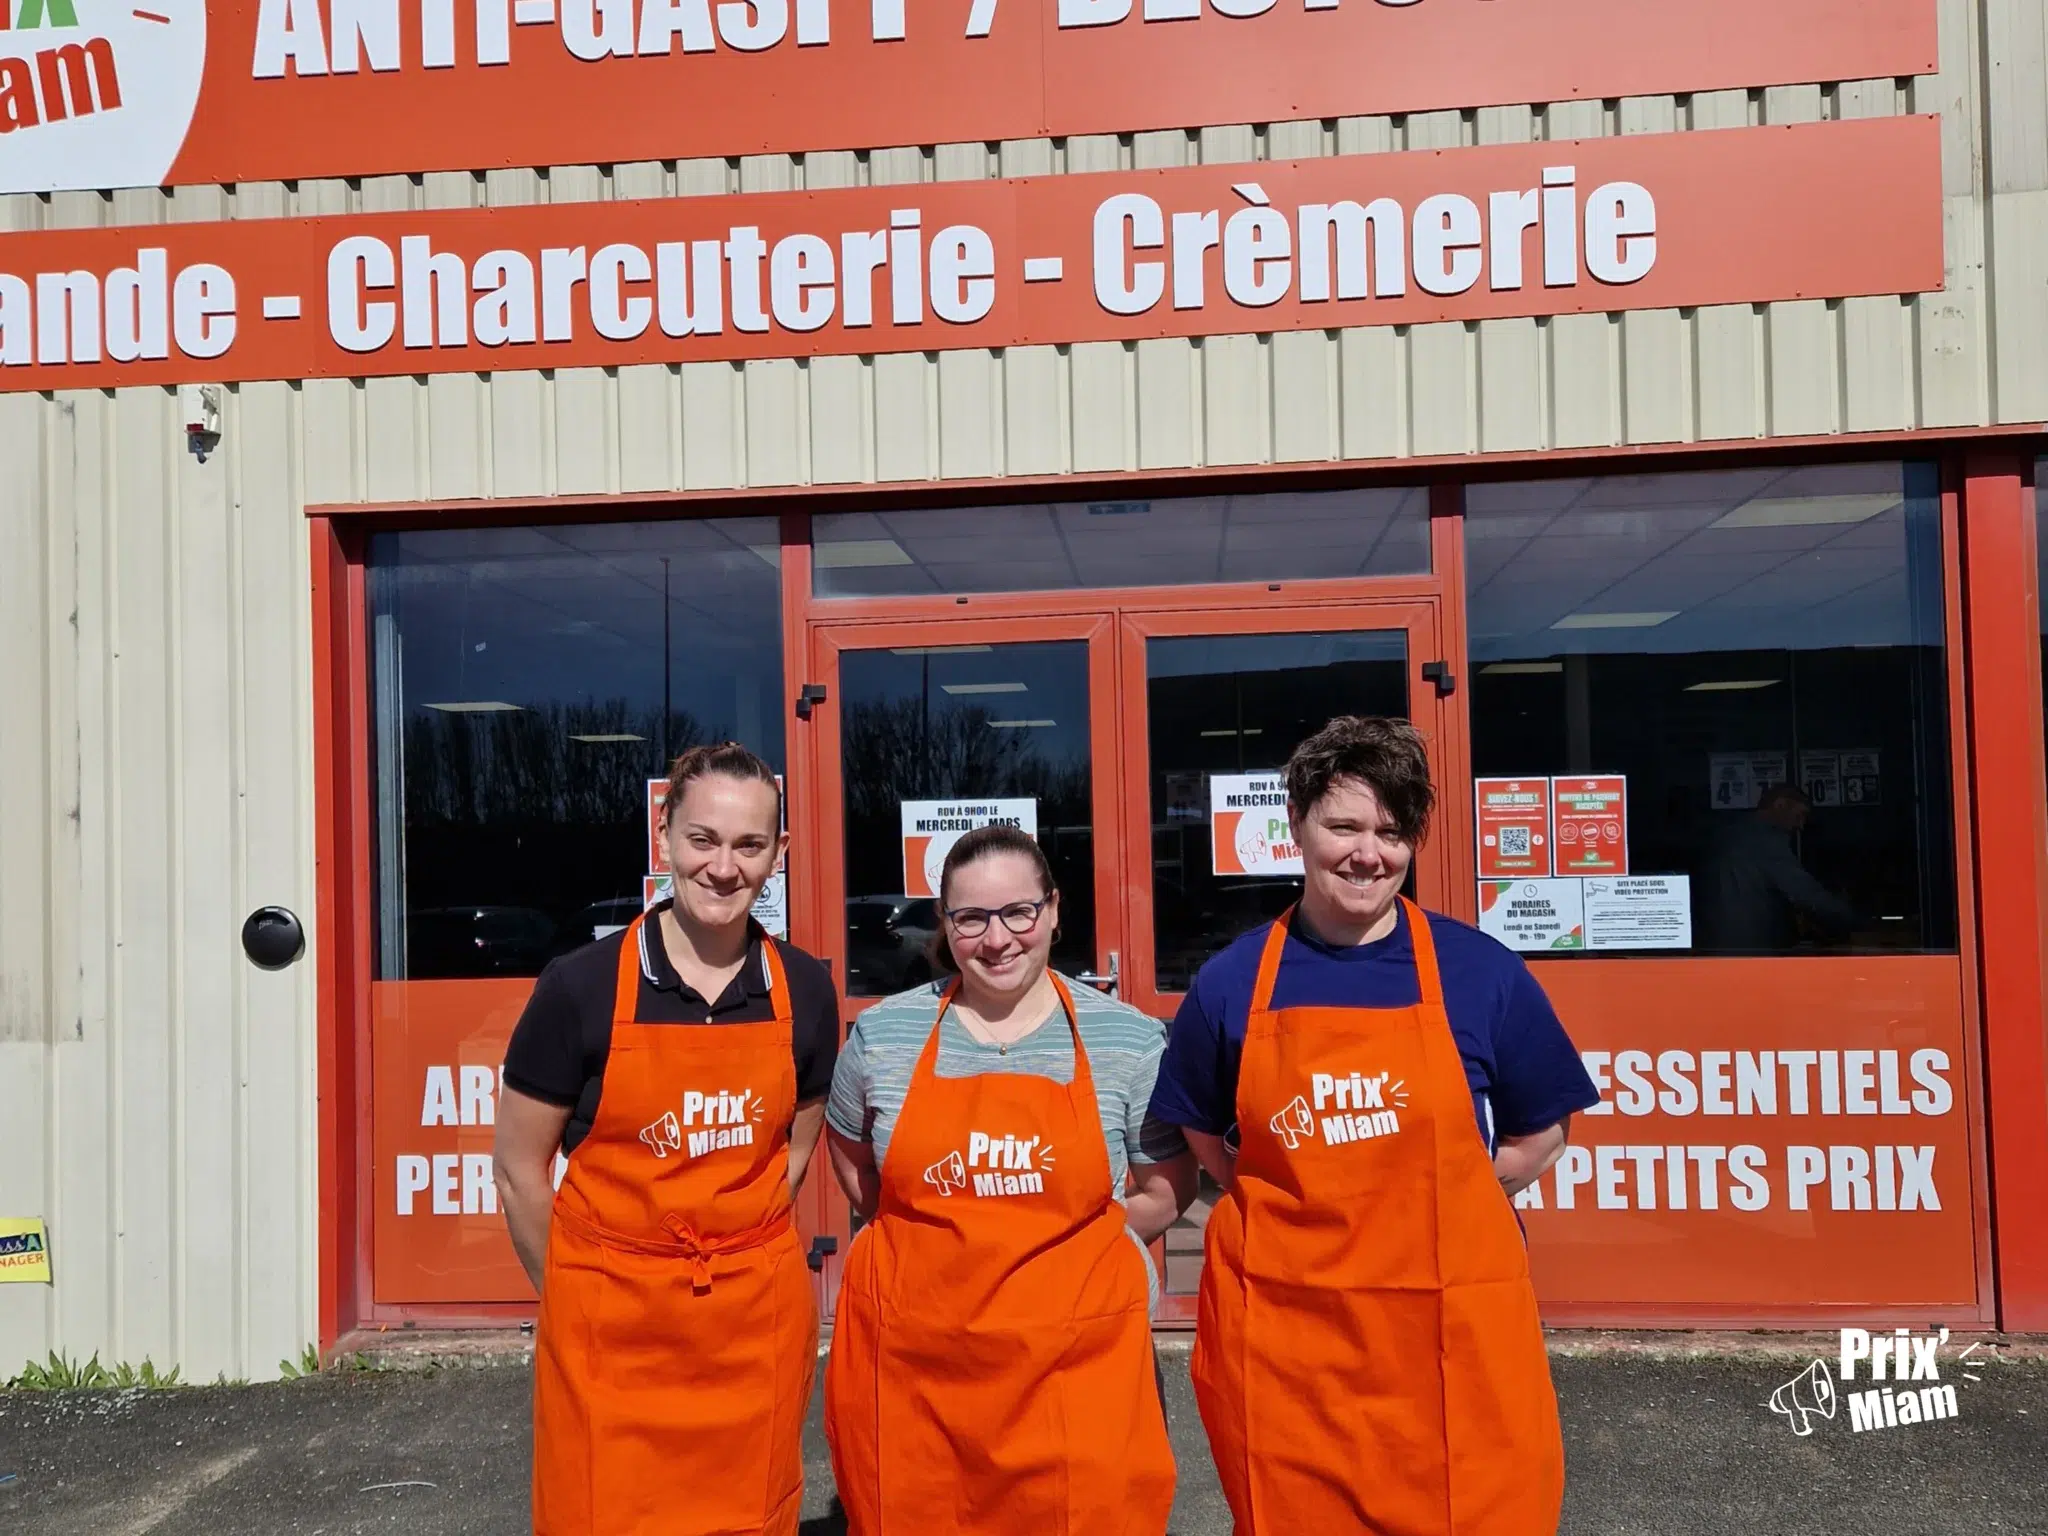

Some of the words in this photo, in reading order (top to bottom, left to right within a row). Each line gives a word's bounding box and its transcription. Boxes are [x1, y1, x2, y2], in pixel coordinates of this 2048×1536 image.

[327, 208, 995, 353] Charcuterie
[1093, 166, 1657, 314] Crèmerie
[1227, 794, 1288, 807] MERCREDI
[1249, 781, 1267, 792] RDV
[916, 819, 972, 832] MERCREDI
[988, 817, 1021, 830] MARS
[937, 807, 956, 817] RDV
[965, 806, 987, 816] 9H00
[990, 805, 998, 815] LE
[1506, 909, 1518, 918] DU
[1519, 908, 1557, 918] MAGASIN
[1511, 900, 1551, 909] HORAIRES
[421, 1064, 505, 1127] AR
[1581, 1048, 1954, 1117] ESSENTIELS
[687, 1123, 754, 1159] Miam
[1320, 1109, 1400, 1147] Miam
[396, 1154, 505, 1216] PER
[973, 1171, 1044, 1198] Miam
[1555, 1144, 1771, 1212] PETITS
[1786, 1145, 1942, 1212] PRIX
